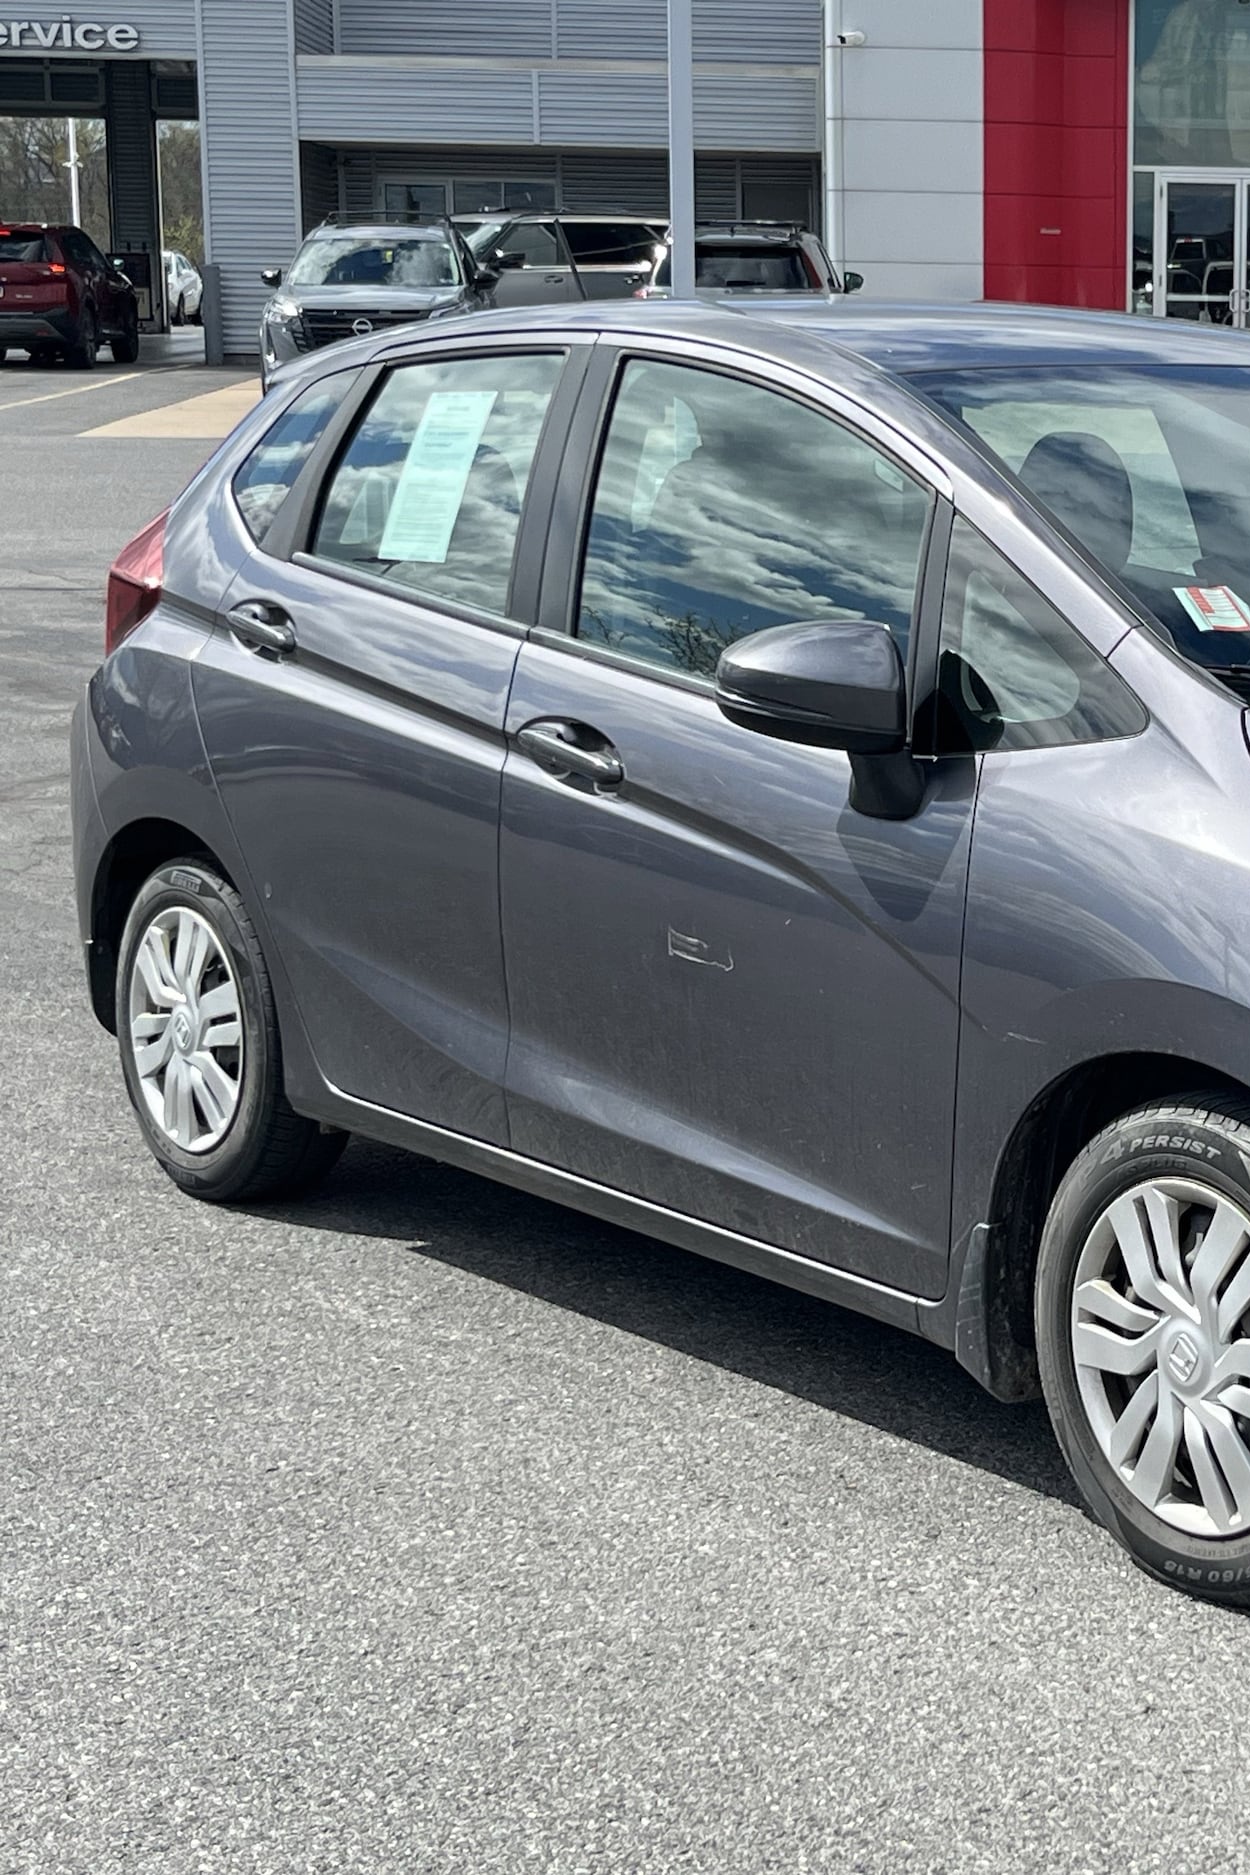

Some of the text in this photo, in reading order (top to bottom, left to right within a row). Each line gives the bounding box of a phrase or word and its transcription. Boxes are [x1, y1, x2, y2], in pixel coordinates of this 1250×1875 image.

[0, 15, 138, 50] rvice
[1129, 1135, 1222, 1160] PERSIST
[1163, 1560, 1202, 1580] R15
